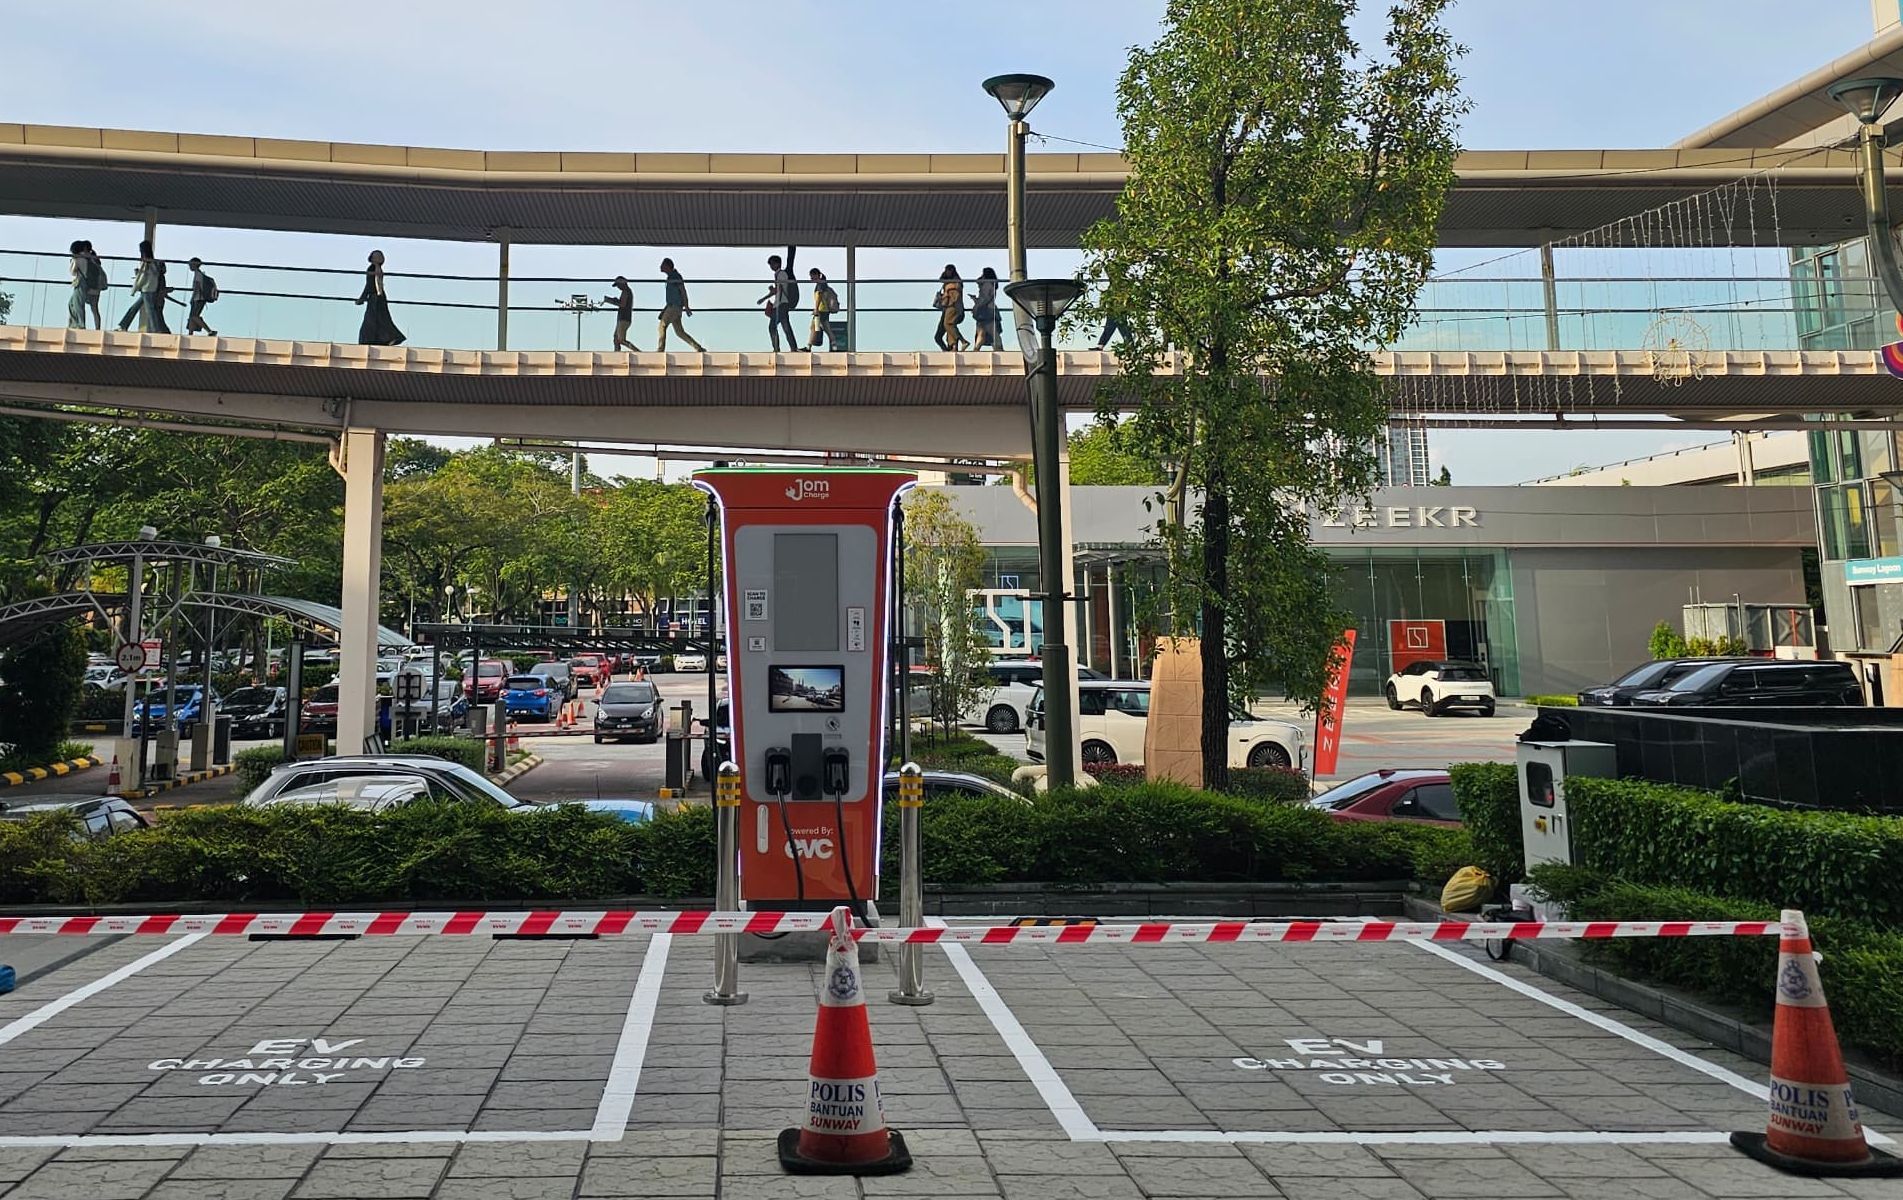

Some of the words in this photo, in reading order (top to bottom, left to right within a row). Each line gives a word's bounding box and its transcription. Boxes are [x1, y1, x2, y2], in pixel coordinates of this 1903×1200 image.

[791, 479, 829, 500] Jom
[804, 492, 829, 500] Charge
[1322, 506, 1479, 527] ZEEKR
[785, 826, 819, 834] owered
[247, 1038, 366, 1055] EV
[1284, 1038, 1384, 1055] EV
[148, 1057, 427, 1070] CHARGING
[1231, 1057, 1506, 1070] CHARGING
[198, 1073, 345, 1085] ONLY
[1319, 1073, 1456, 1085] ONLY
[811, 1081, 865, 1102] POLIS
[1771, 1081, 1829, 1109] POLIS
[810, 1102, 863, 1117] BANTUAN
[1770, 1100, 1828, 1122] BANTUAN
[810, 1116, 861, 1130] SUNWAY
[1771, 1113, 1824, 1134] SUNWAY
